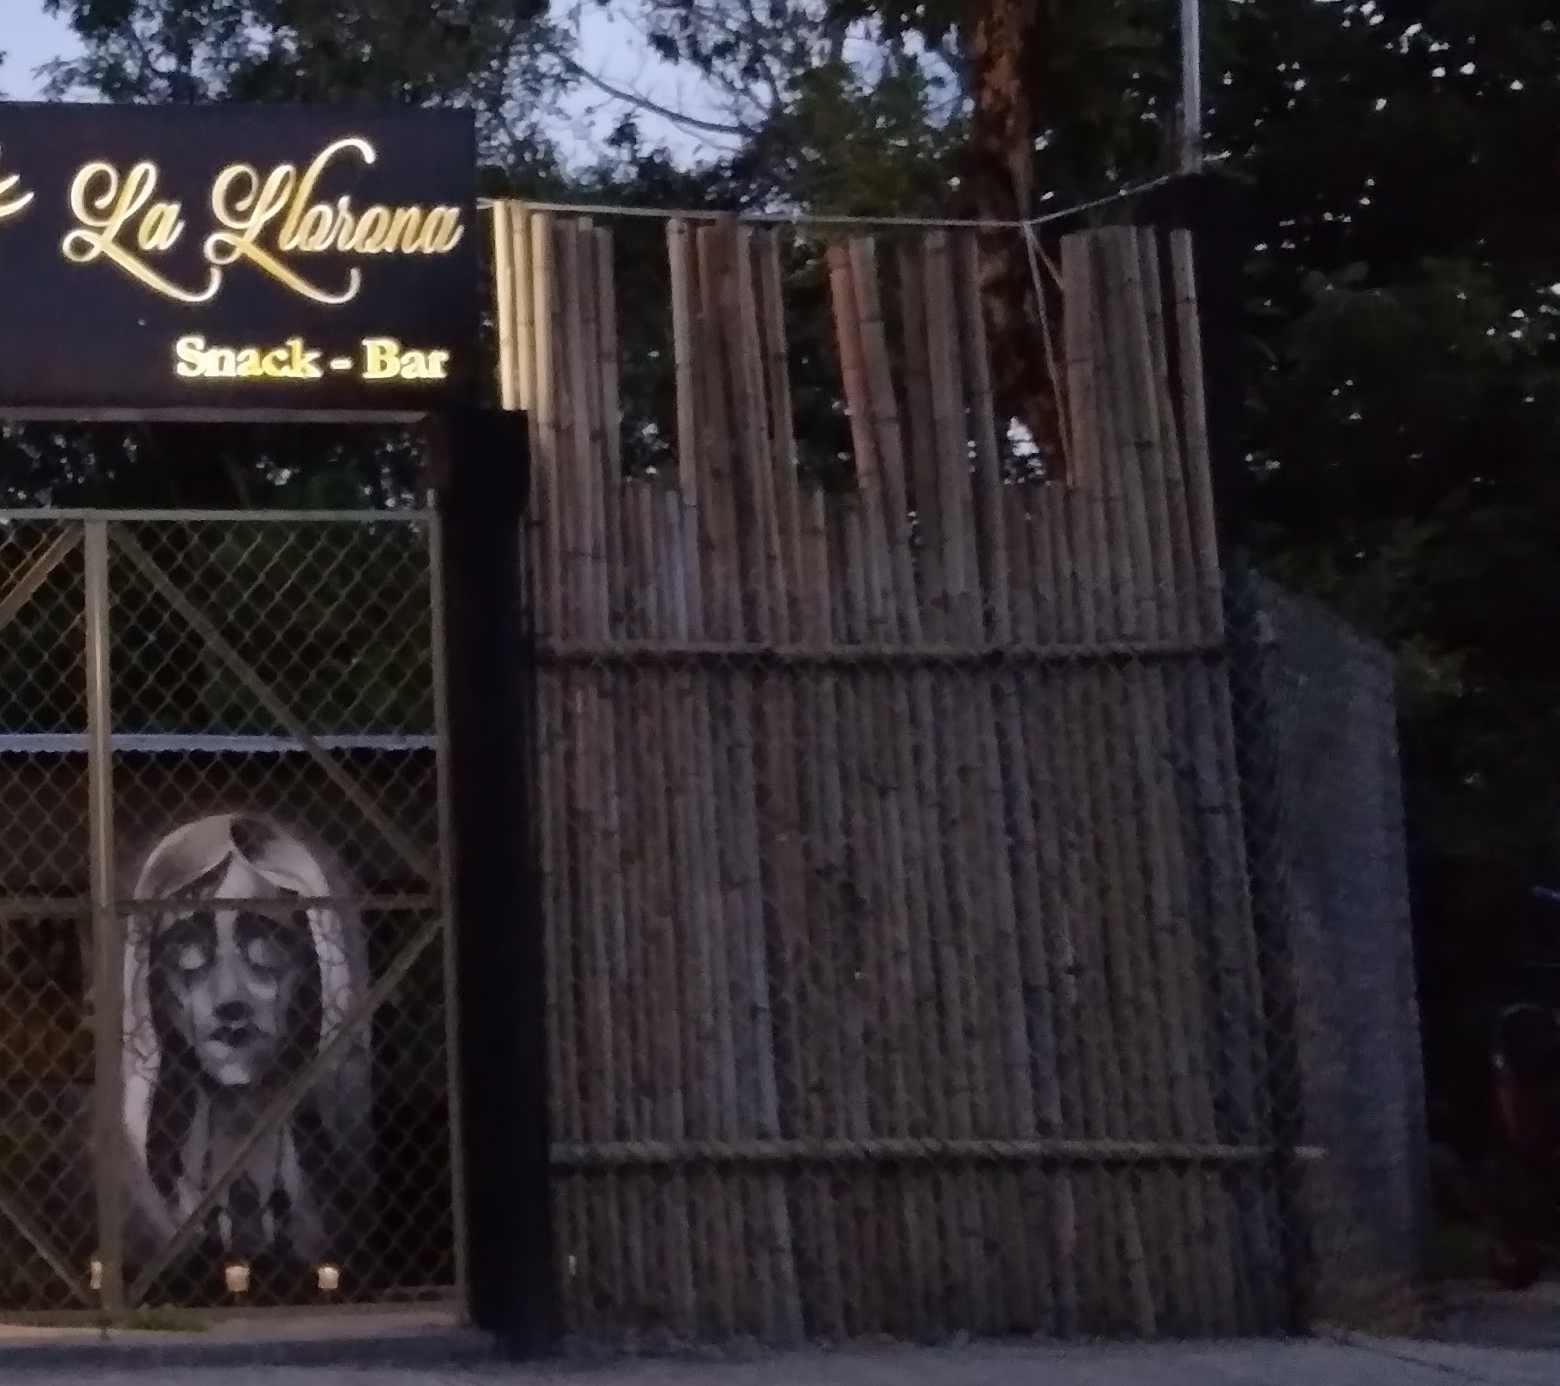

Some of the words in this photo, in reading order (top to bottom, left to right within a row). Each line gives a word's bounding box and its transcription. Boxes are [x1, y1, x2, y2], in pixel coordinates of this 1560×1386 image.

[61, 159, 224, 303] La
[202, 136, 466, 305] Llorona
[174, 334, 324, 380] Snack
[361, 335, 451, 381] Bar
